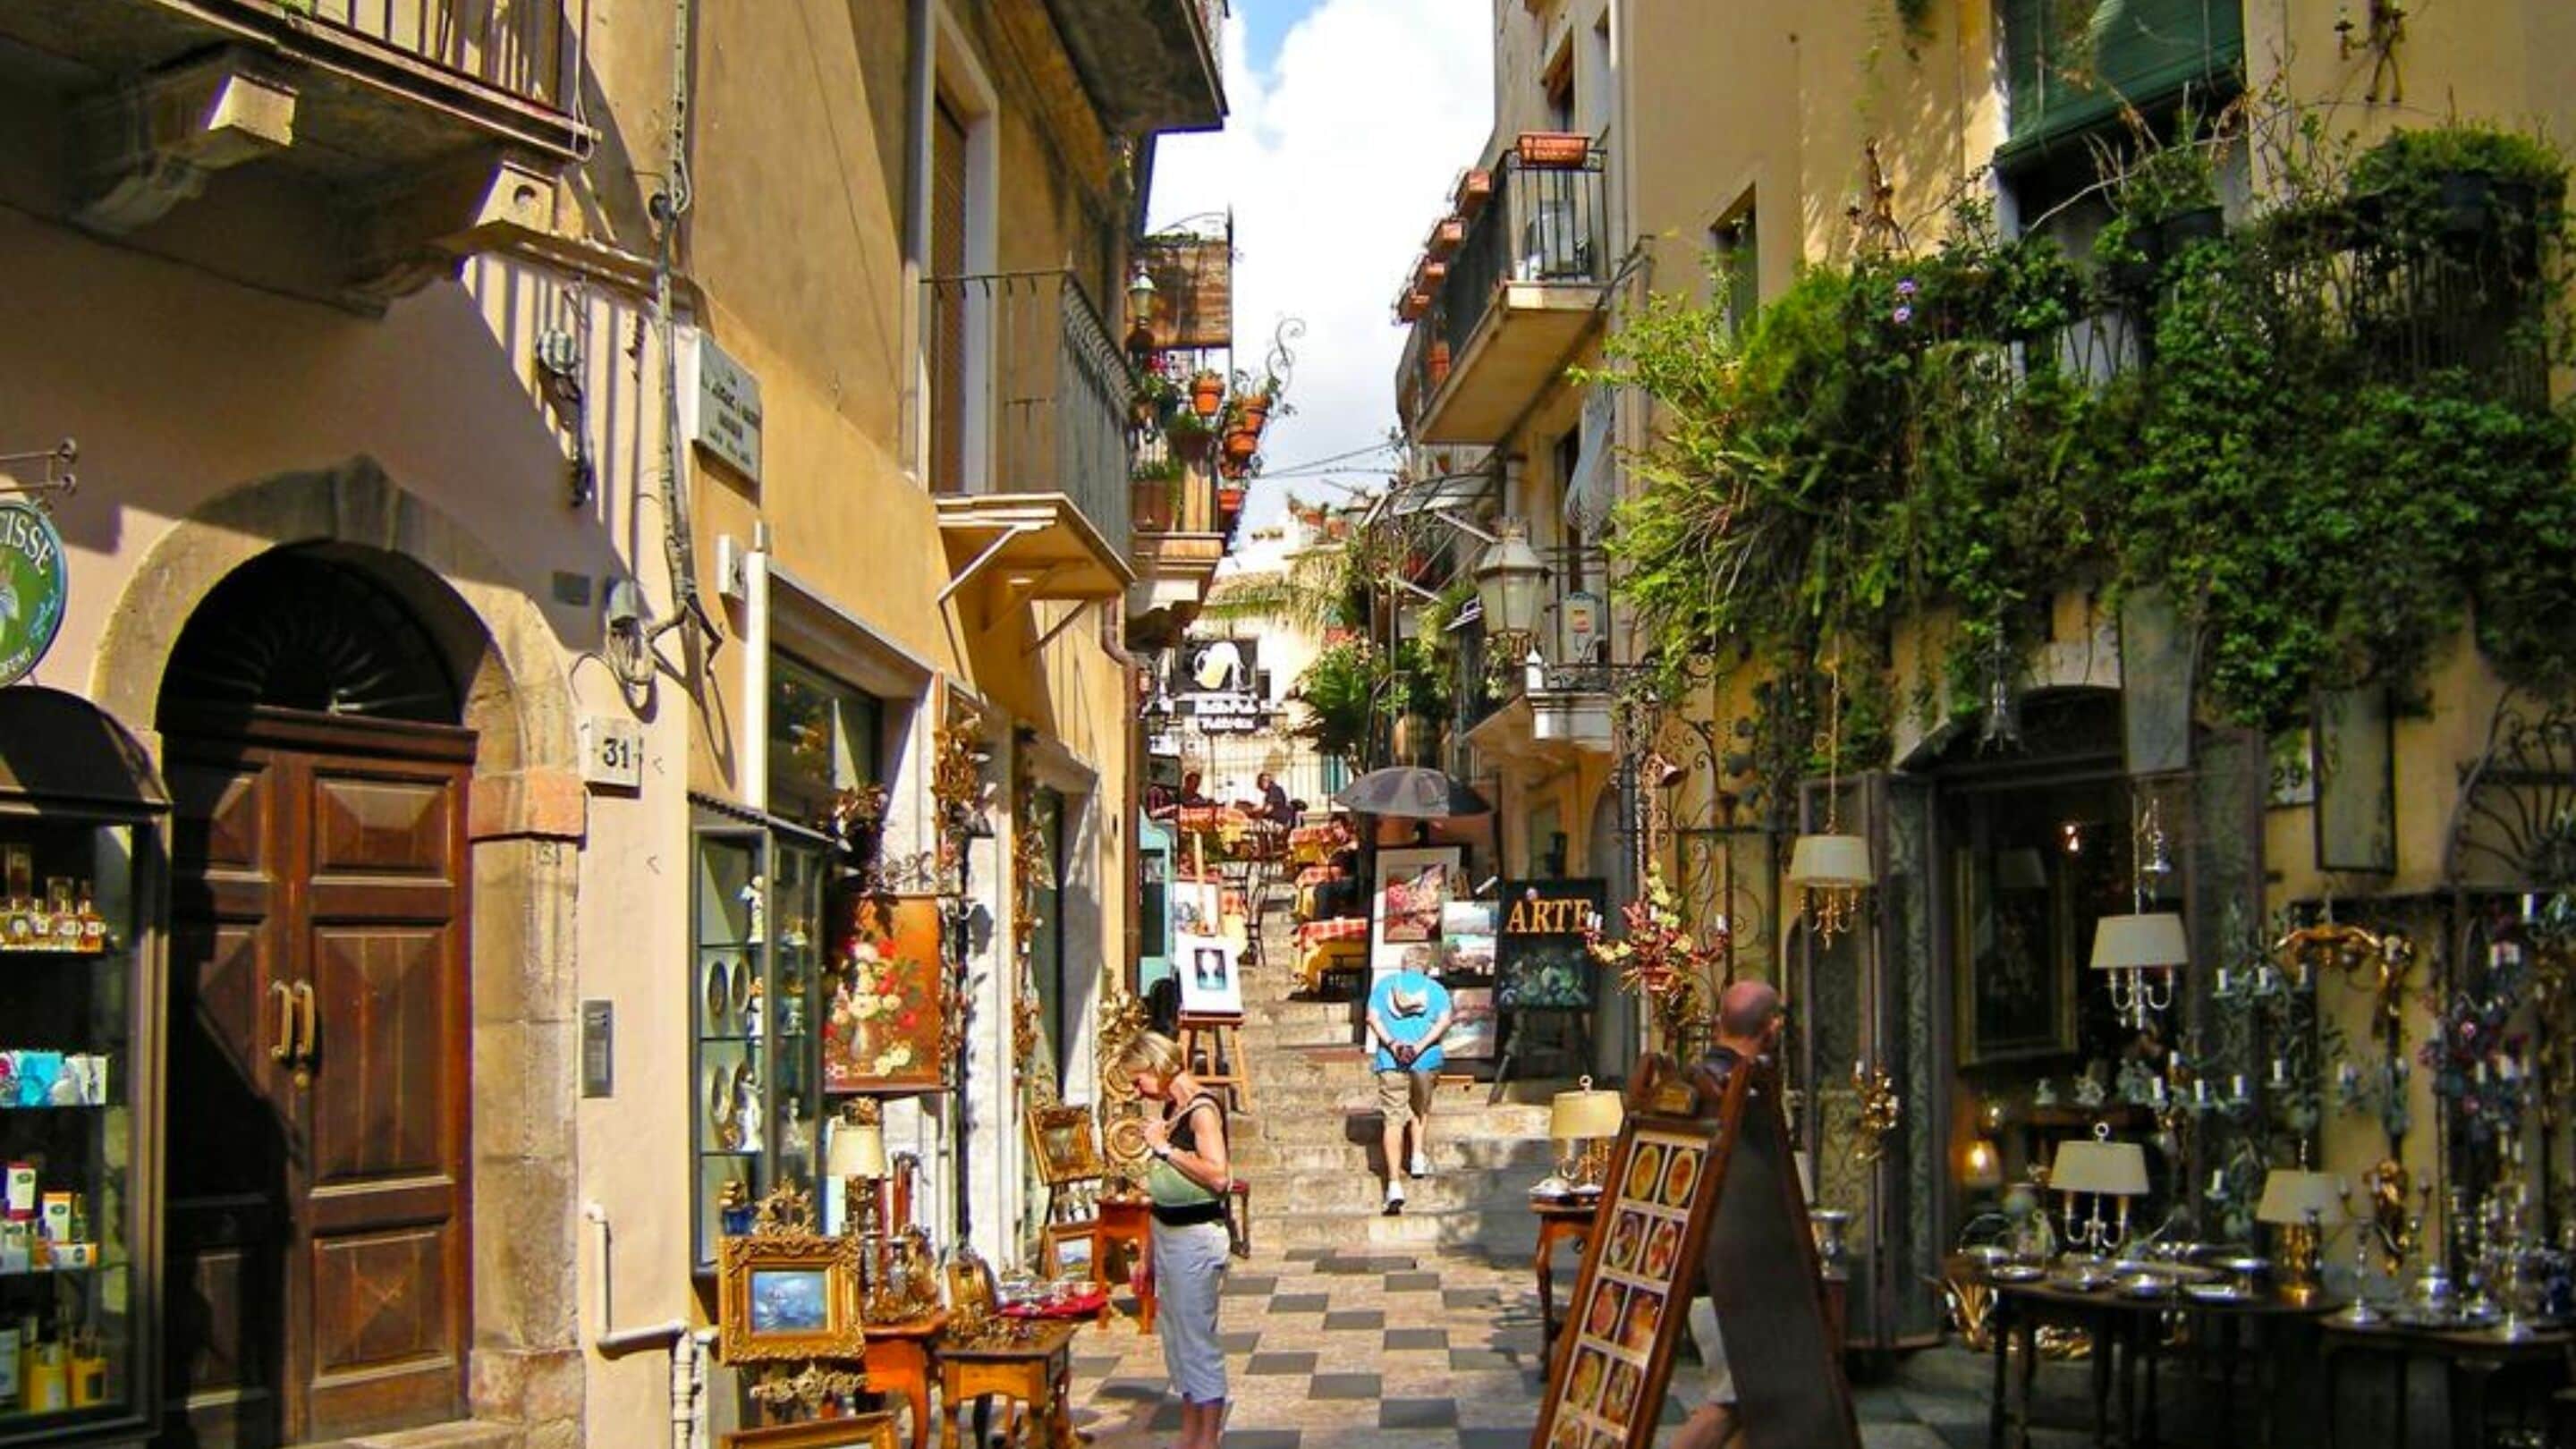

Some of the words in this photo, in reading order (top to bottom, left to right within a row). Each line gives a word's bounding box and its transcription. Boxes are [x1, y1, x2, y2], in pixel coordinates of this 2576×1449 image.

[603, 737, 631, 770] 31
[2270, 765, 2304, 792] 29
[1504, 898, 1593, 933] ARTE
